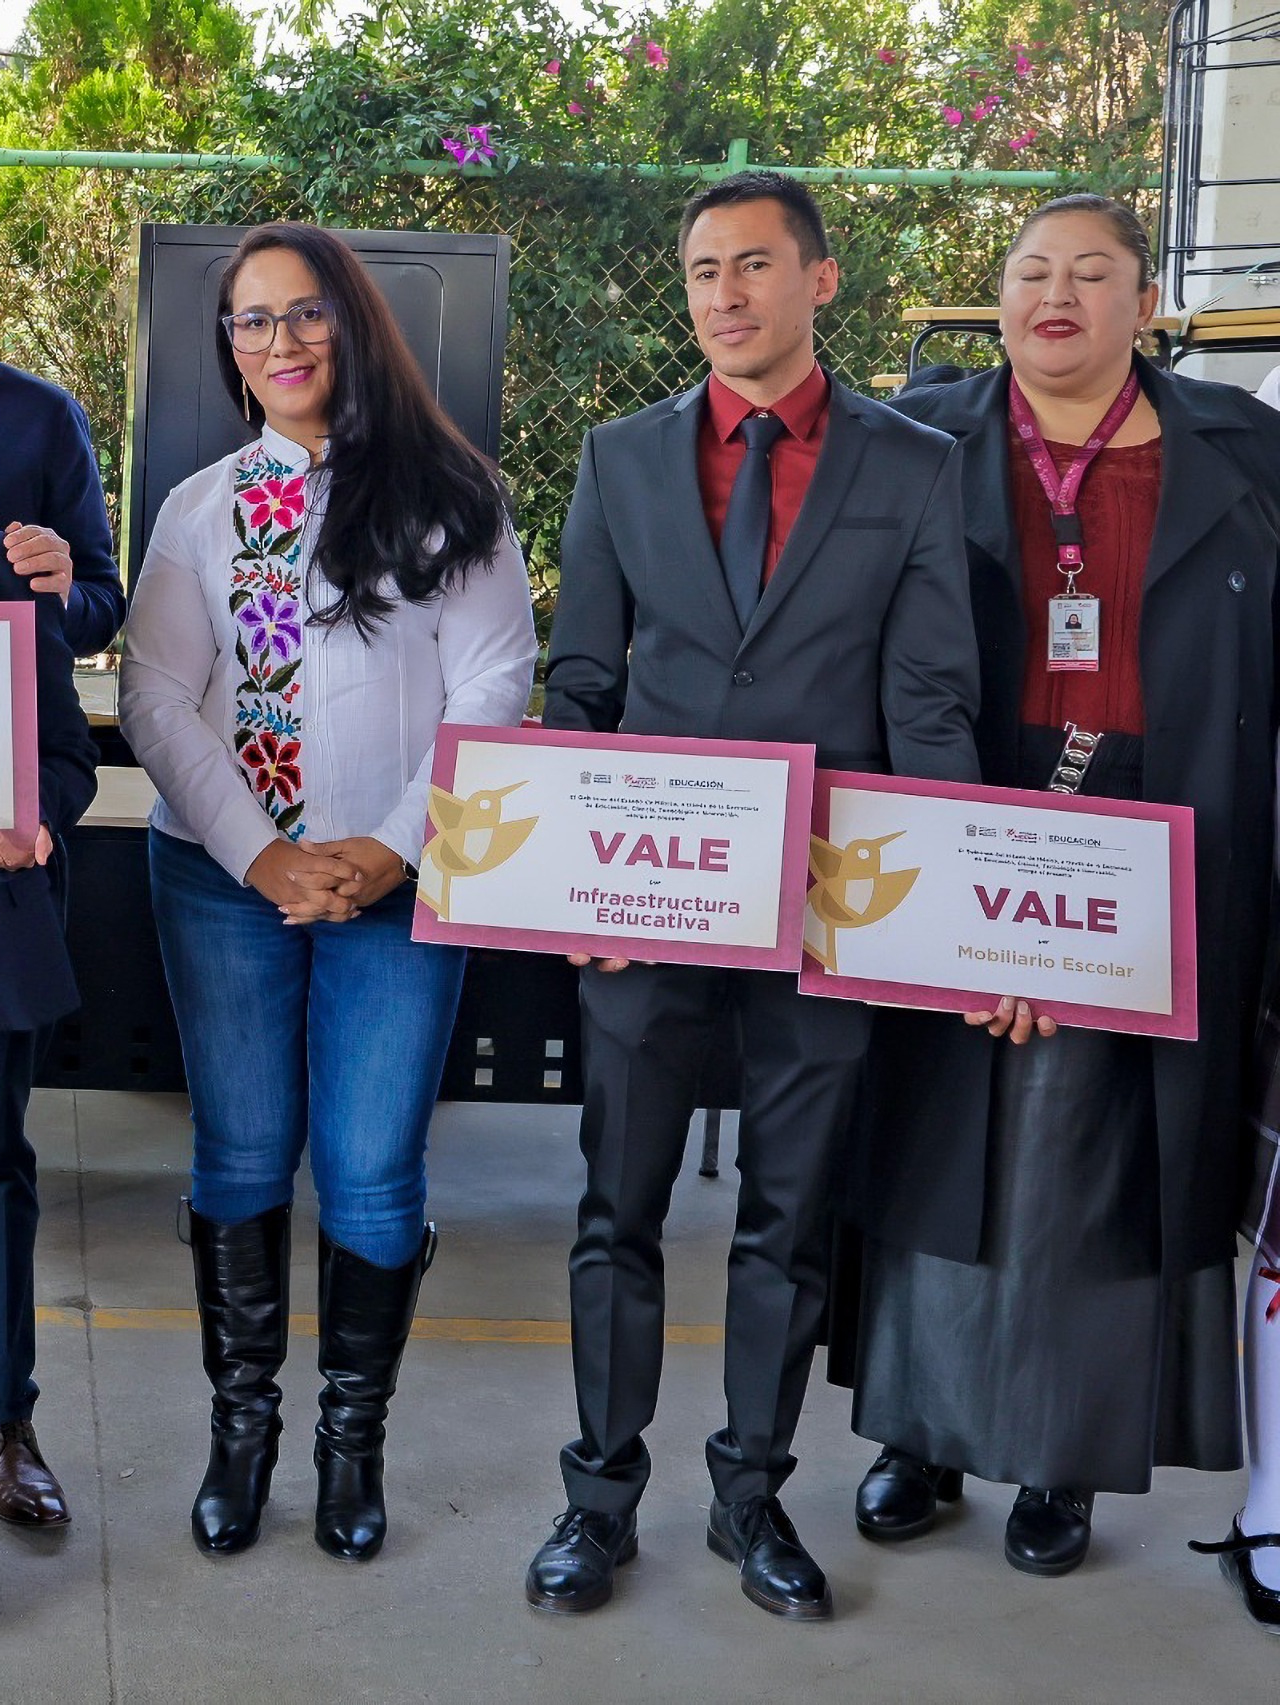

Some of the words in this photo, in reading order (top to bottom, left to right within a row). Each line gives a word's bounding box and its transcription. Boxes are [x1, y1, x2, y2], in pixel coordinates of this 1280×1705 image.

[589, 830, 730, 873] VALE
[569, 887, 740, 915] Infraestructura
[972, 884, 1118, 934] VALE
[596, 907, 710, 932] Educativa
[958, 944, 1056, 969] Mobiliario
[1062, 957, 1135, 978] Escolar
